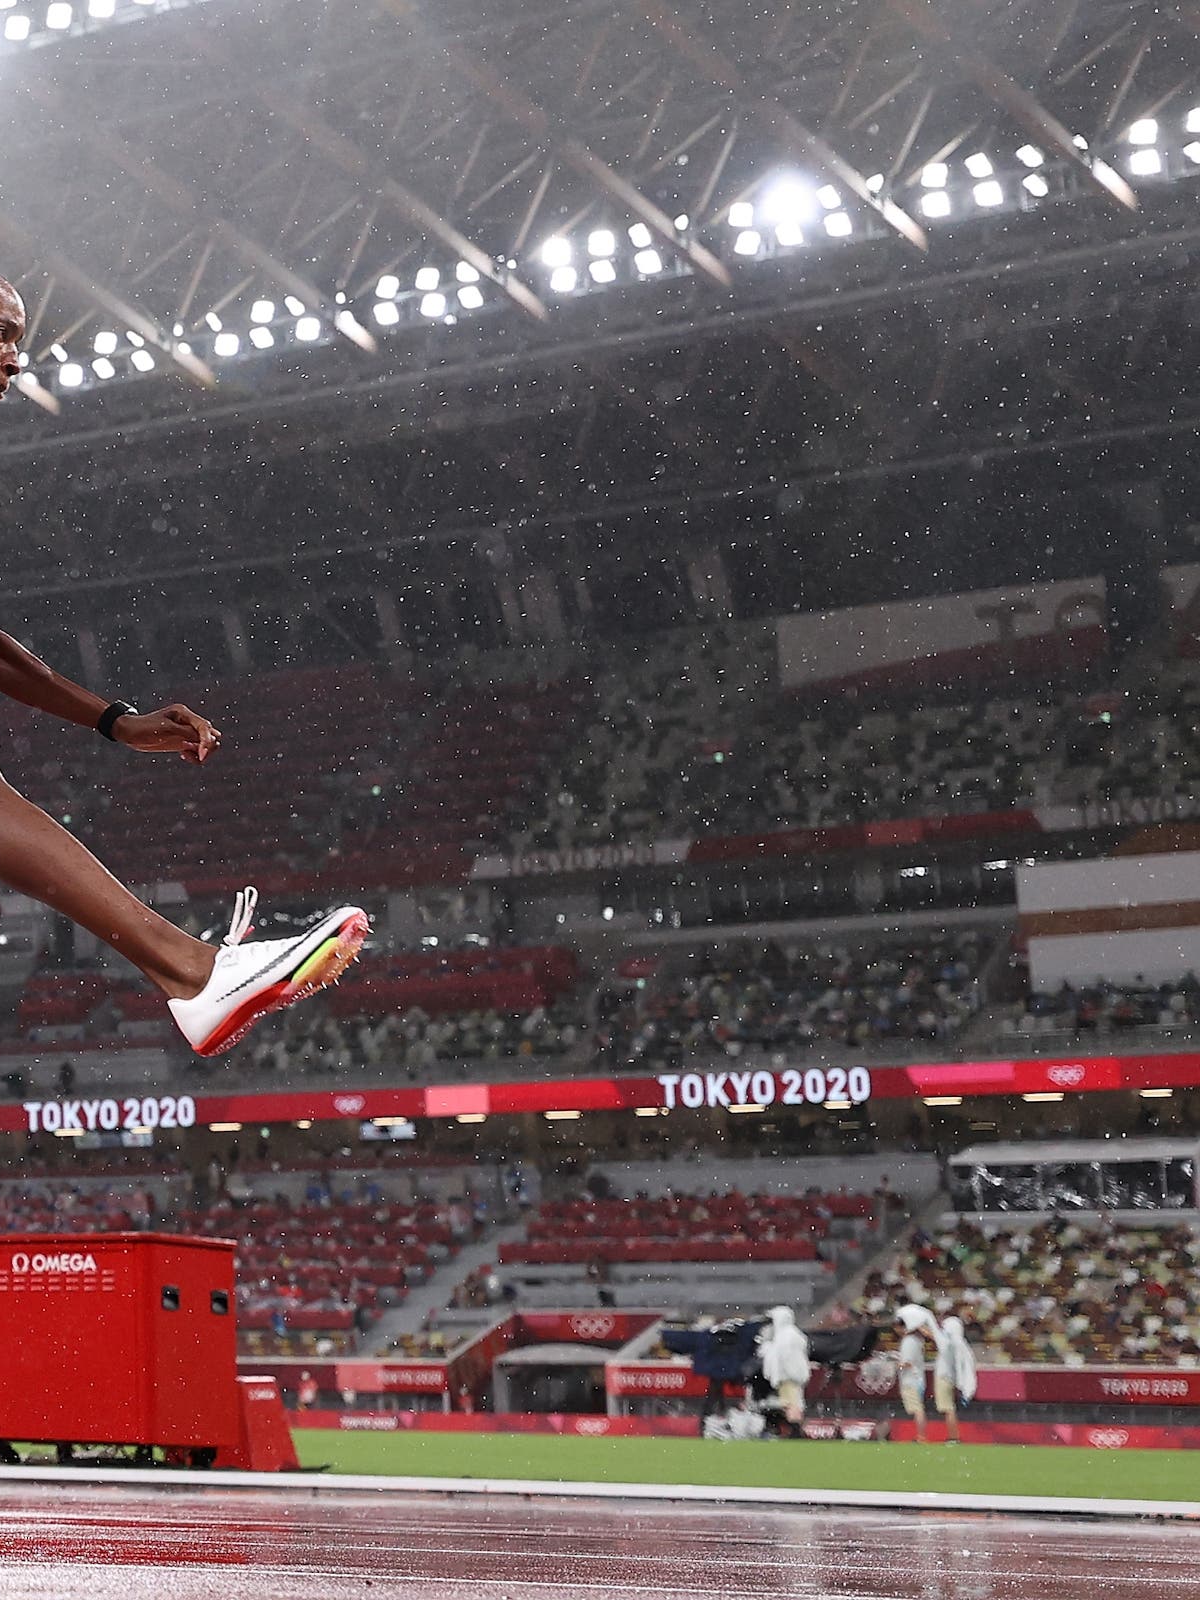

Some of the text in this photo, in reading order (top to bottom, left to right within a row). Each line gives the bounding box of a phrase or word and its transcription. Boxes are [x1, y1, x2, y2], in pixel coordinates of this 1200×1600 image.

[658, 1066, 871, 1109] TOKYO 2020
[23, 1095, 196, 1133] TOKYO 2020
[31, 1253, 97, 1273] OMEGA
[1100, 1378, 1189, 1397] TOKYO 2020
